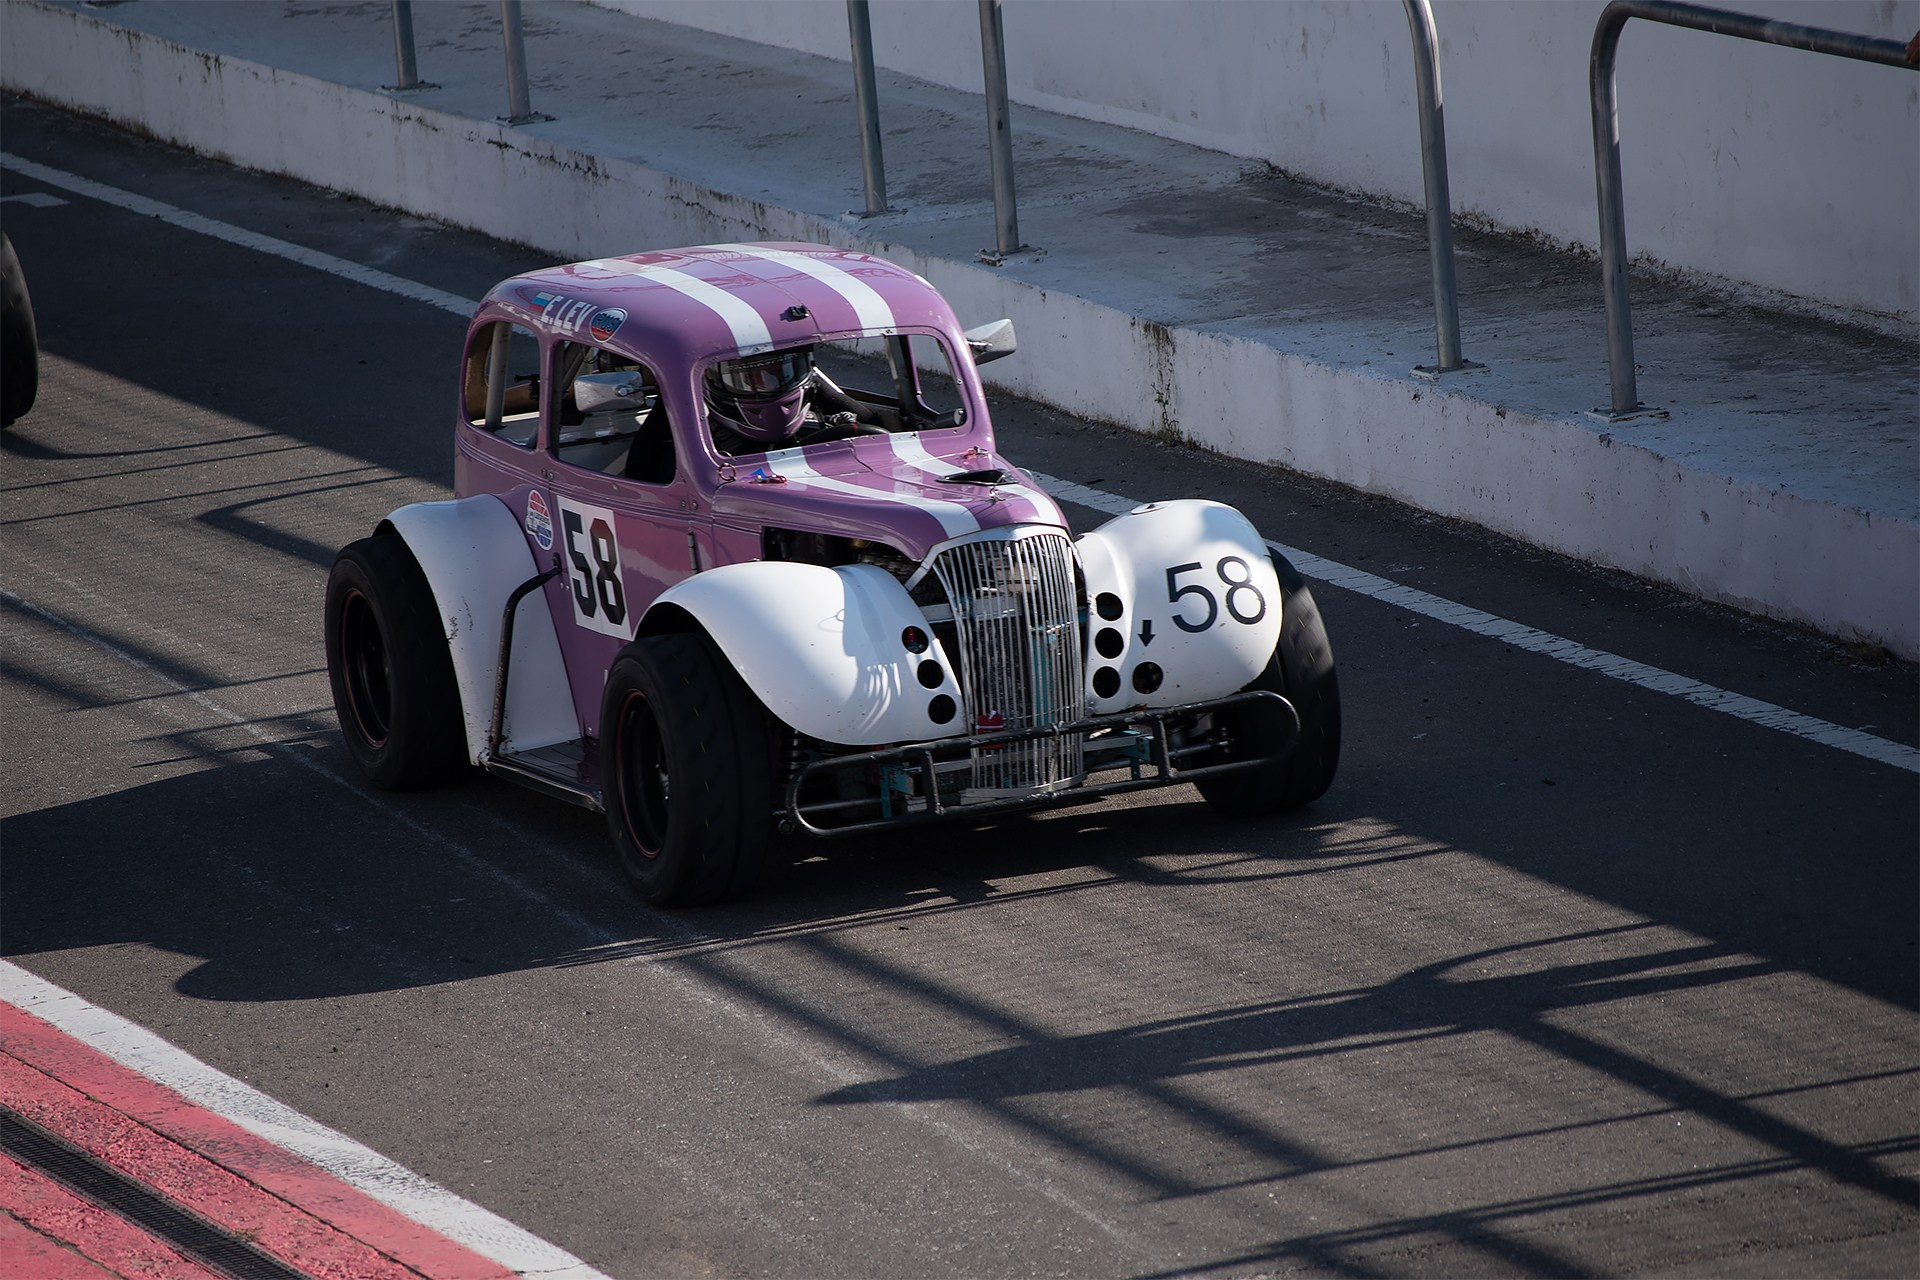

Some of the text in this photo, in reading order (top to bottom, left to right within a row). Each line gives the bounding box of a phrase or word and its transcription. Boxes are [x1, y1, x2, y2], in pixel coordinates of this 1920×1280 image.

[541, 295, 598, 333] E.LEV
[562, 508, 626, 626] 58
[1166, 556, 1266, 633] 58
